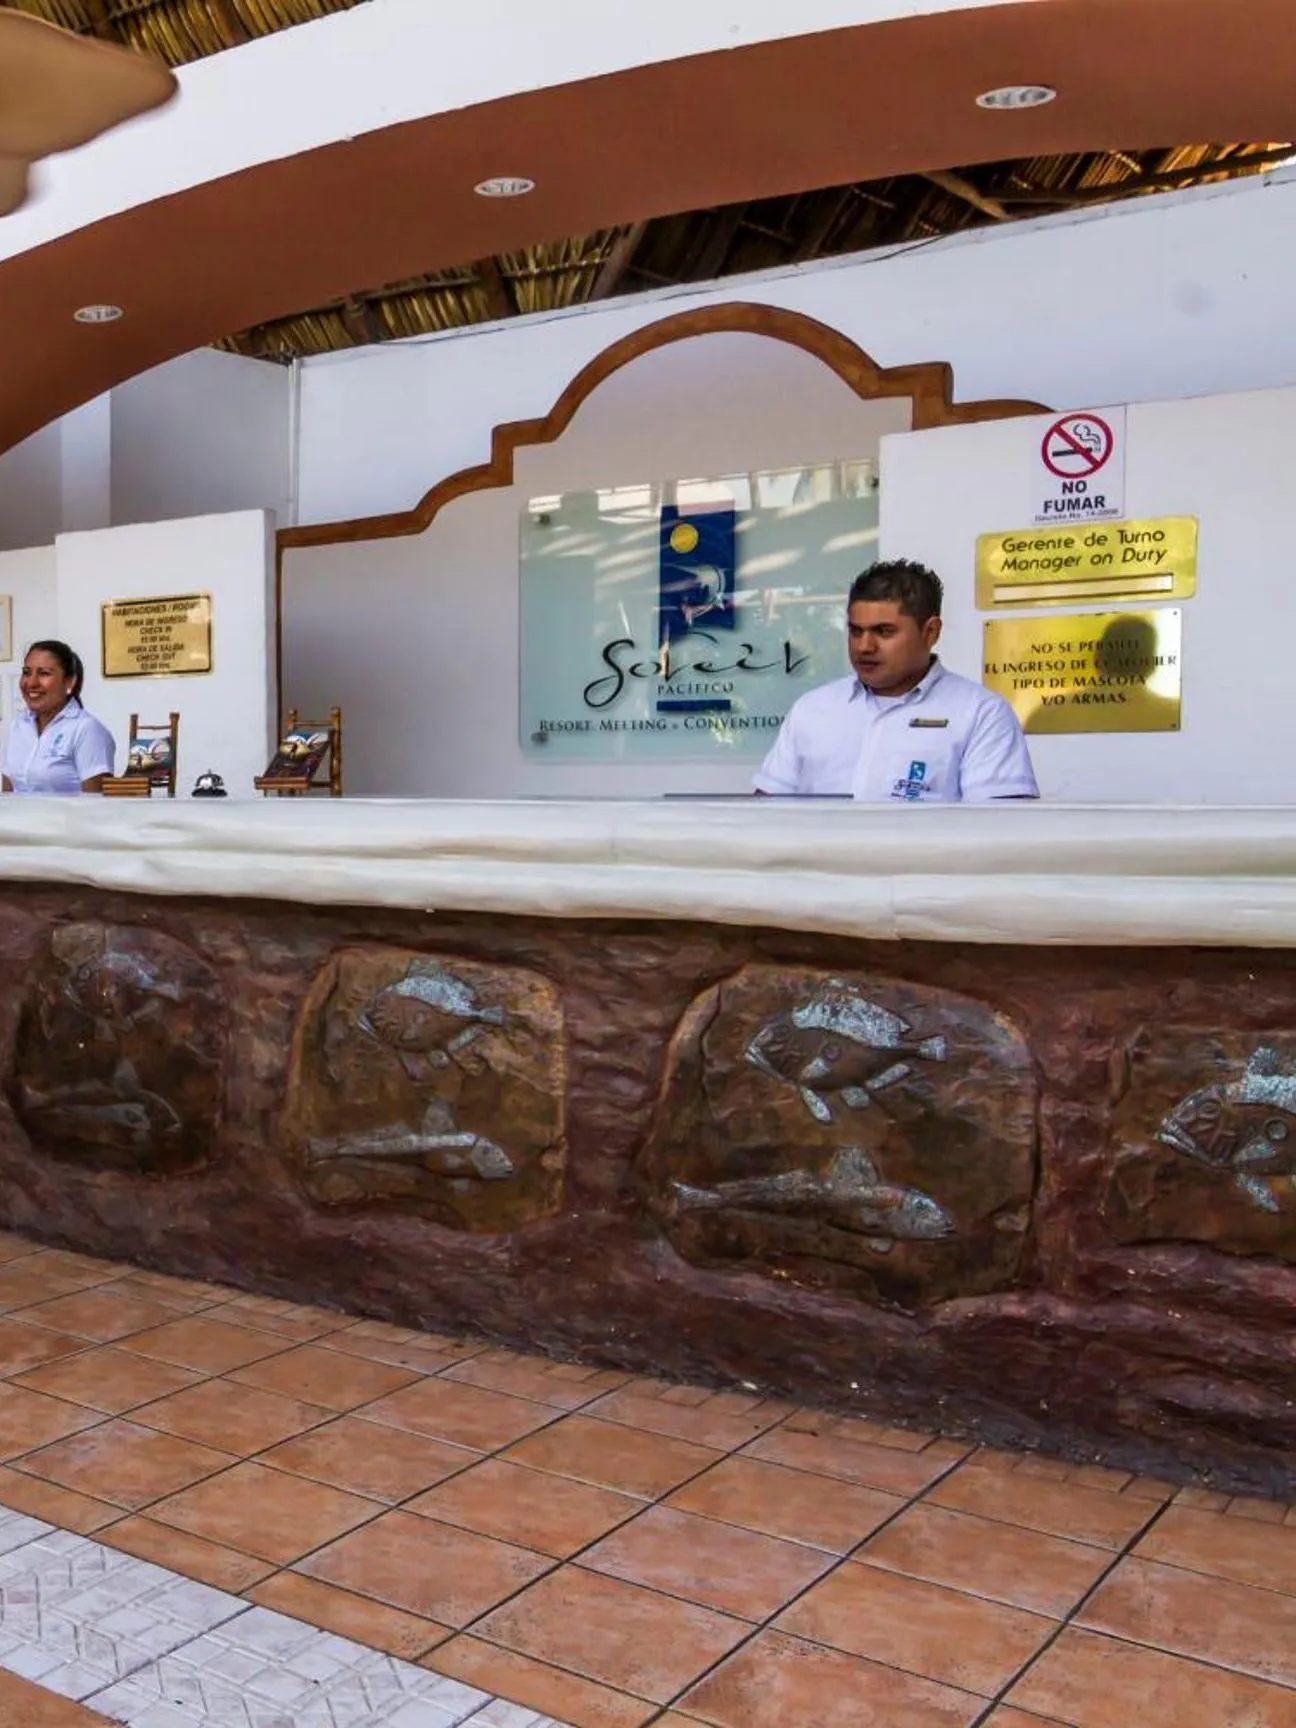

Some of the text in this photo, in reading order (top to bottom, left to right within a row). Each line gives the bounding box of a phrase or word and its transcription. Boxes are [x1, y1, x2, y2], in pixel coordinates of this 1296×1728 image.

[1062, 480, 1087, 494] NO
[1043, 495, 1106, 514] FUMAR
[1001, 529, 1166, 554] Gerente de Turno
[1000, 547, 1167, 573] Manager on Duty
[1031, 641, 1053, 654] NO
[1058, 640, 1072, 652] SE
[985, 662, 999, 675] EL
[1003, 660, 1066, 674] INGRESO
[1071, 658, 1087, 670] DE
[1012, 674, 1147, 690] TIPO DE MASCOTA
[1041, 692, 1128, 706] Y/O ARMAS
